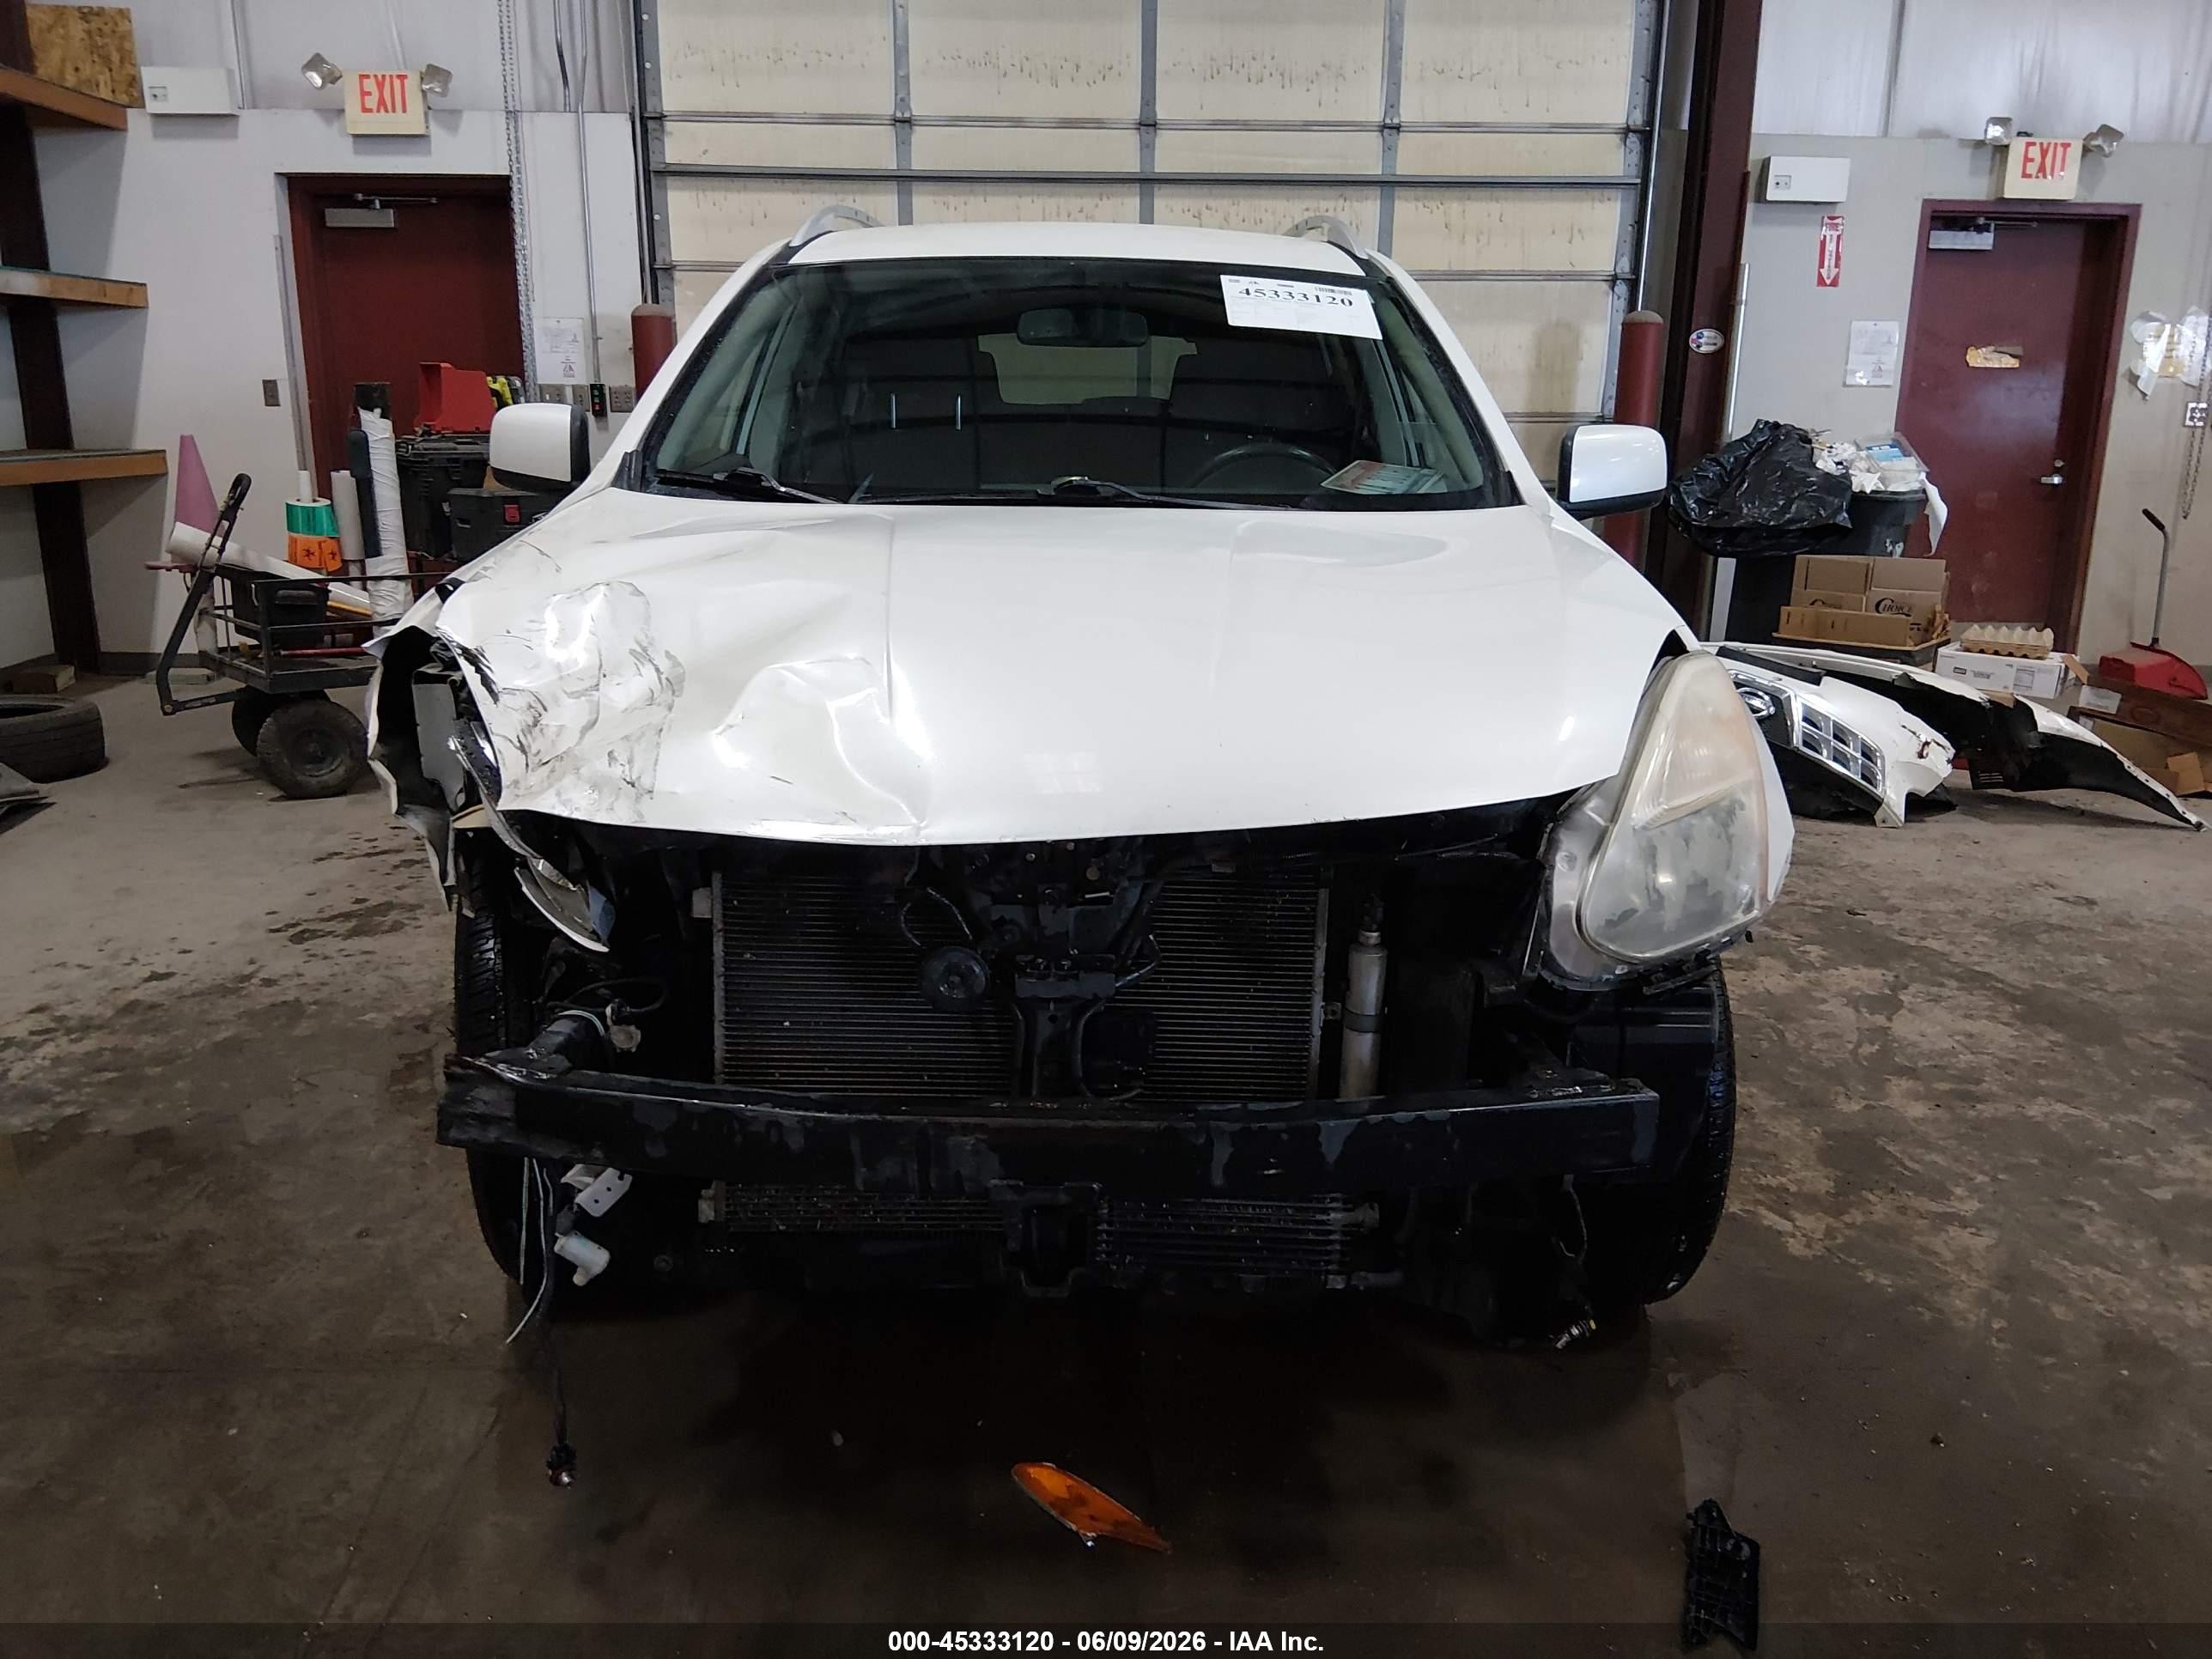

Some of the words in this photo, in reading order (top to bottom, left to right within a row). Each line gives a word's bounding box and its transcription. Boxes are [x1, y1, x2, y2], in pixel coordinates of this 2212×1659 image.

[358, 74, 408, 113] EXIT
[2021, 141, 2072, 179] EXIT
[1238, 288, 1353, 307] 45333120
